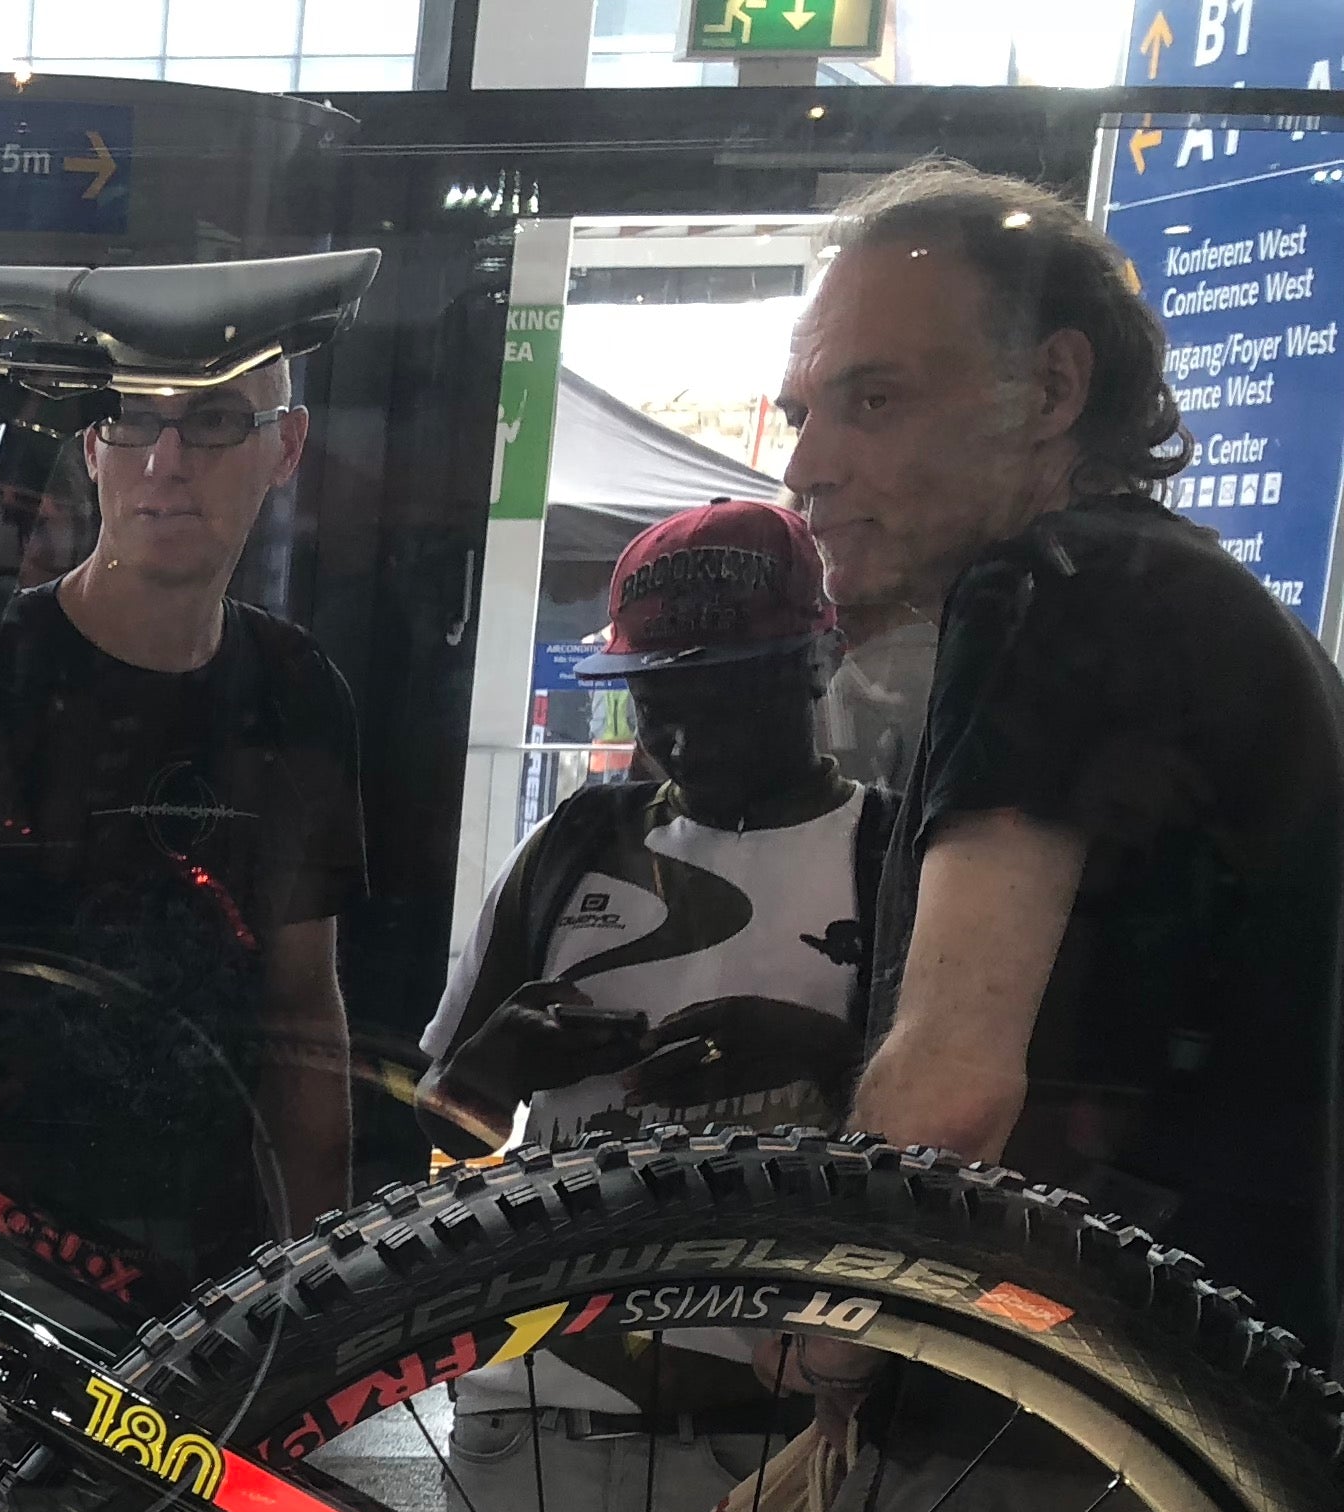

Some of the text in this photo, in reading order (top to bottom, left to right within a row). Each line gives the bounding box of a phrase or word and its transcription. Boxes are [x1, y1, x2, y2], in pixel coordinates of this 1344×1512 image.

[1194, 0, 1254, 67] B1
[1166, 224, 1308, 277] Konferenz West
[1163, 267, 1315, 318] Conference West
[505, 309, 560, 331] KING
[503, 341, 534, 363] EA
[1163, 321, 1338, 380] ingang/Foyer West
[1227, 372, 1275, 407] West
[1208, 432, 1269, 465] Center
[619, 1285, 883, 1331] DT SWISS
